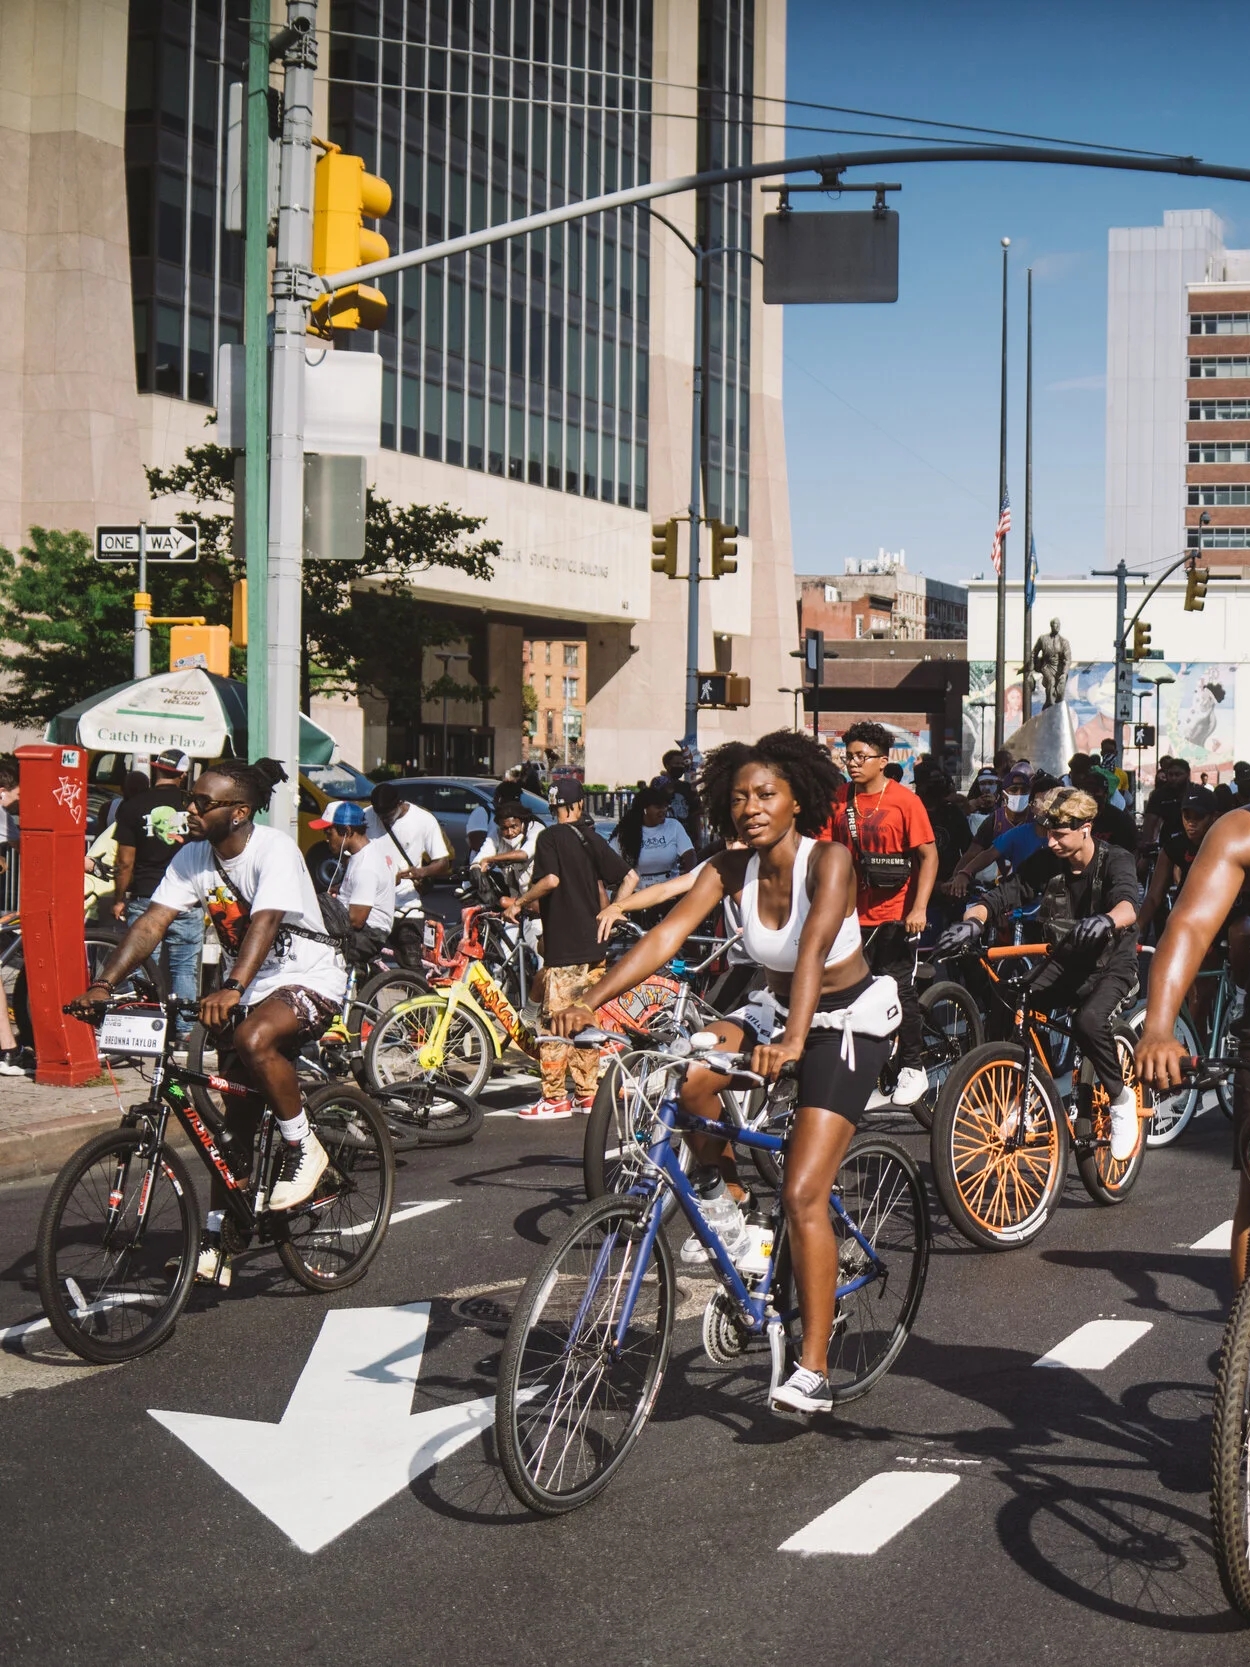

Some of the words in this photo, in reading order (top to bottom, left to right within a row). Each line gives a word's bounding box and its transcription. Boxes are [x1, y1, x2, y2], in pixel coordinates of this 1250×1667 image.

[105, 536, 134, 550] ONE
[151, 536, 182, 550] WAY
[98, 728, 138, 743] Catch
[144, 732, 165, 745] the
[170, 733, 206, 749] Flava
[871, 858, 905, 866] SUPREME
[105, 1036, 130, 1046] BREONNA
[132, 1038, 157, 1048] TAYLOR
[183, 1107, 239, 1189] MONGOOSE
